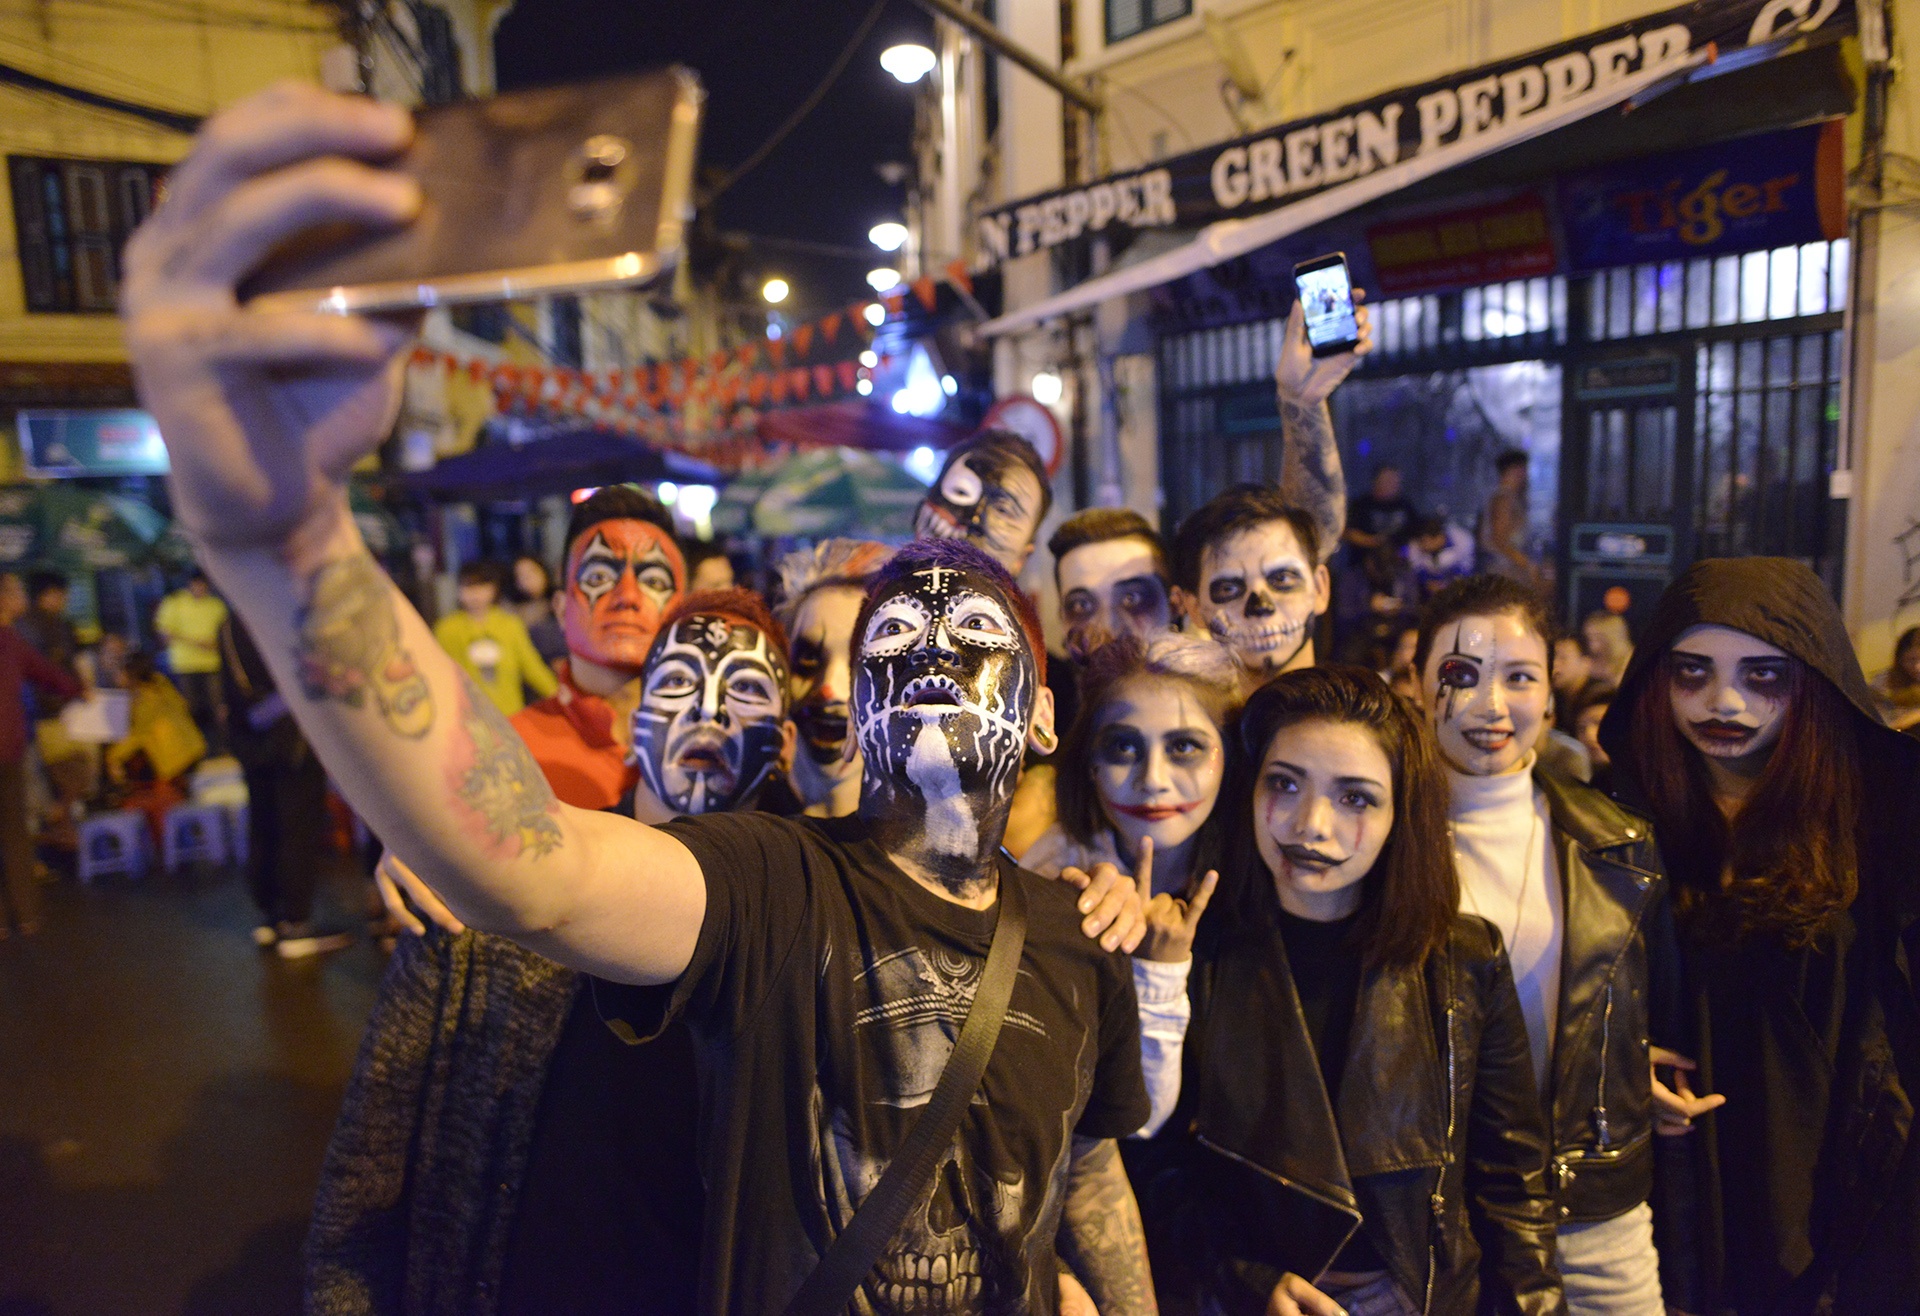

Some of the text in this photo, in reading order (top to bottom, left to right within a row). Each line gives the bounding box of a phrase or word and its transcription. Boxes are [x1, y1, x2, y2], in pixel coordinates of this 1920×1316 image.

[1210, 102, 1404, 210] GREEN
[1014, 167, 1178, 254] PEPPER
[1612, 168, 1800, 245] Tiger
